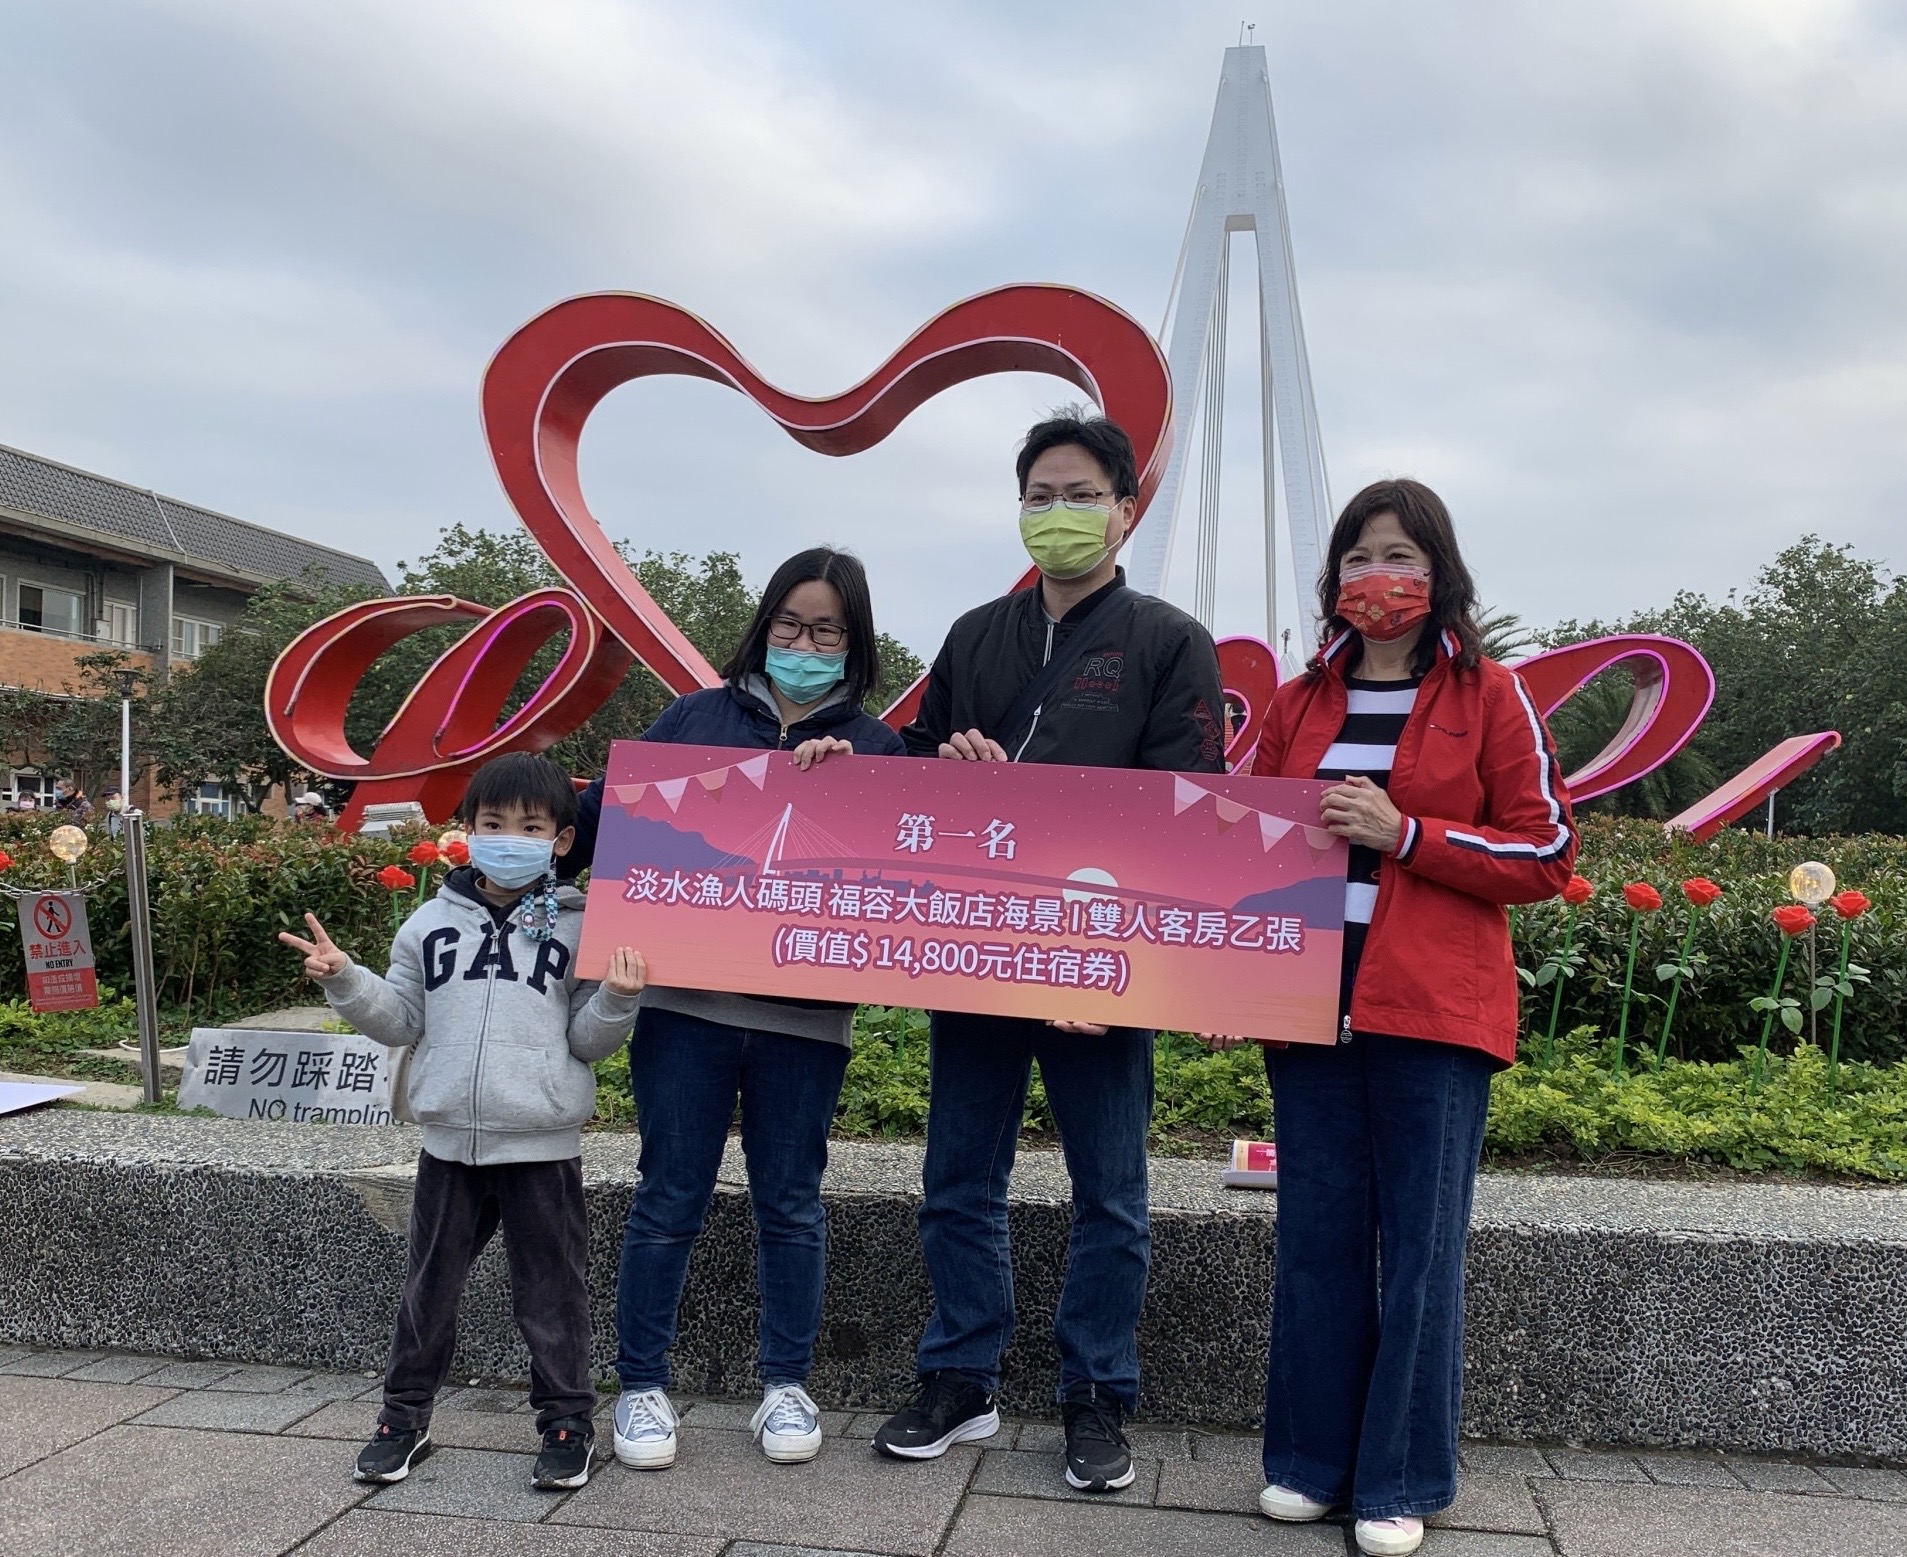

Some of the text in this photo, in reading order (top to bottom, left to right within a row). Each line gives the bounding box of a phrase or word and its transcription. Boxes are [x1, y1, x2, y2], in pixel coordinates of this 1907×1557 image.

[1083, 656, 1123, 679] RQ
[894, 812, 1017, 860] 第一名
[625, 867, 824, 915] 淡水漁人碼頭
[29, 939, 87, 960] 禁止進入
[45, 958, 74, 969] NO ENTRY
[422, 920, 570, 995] GAP
[204, 1045, 388, 1093] 請勿踩踏
[248, 1098, 403, 1126] NO tramplin
